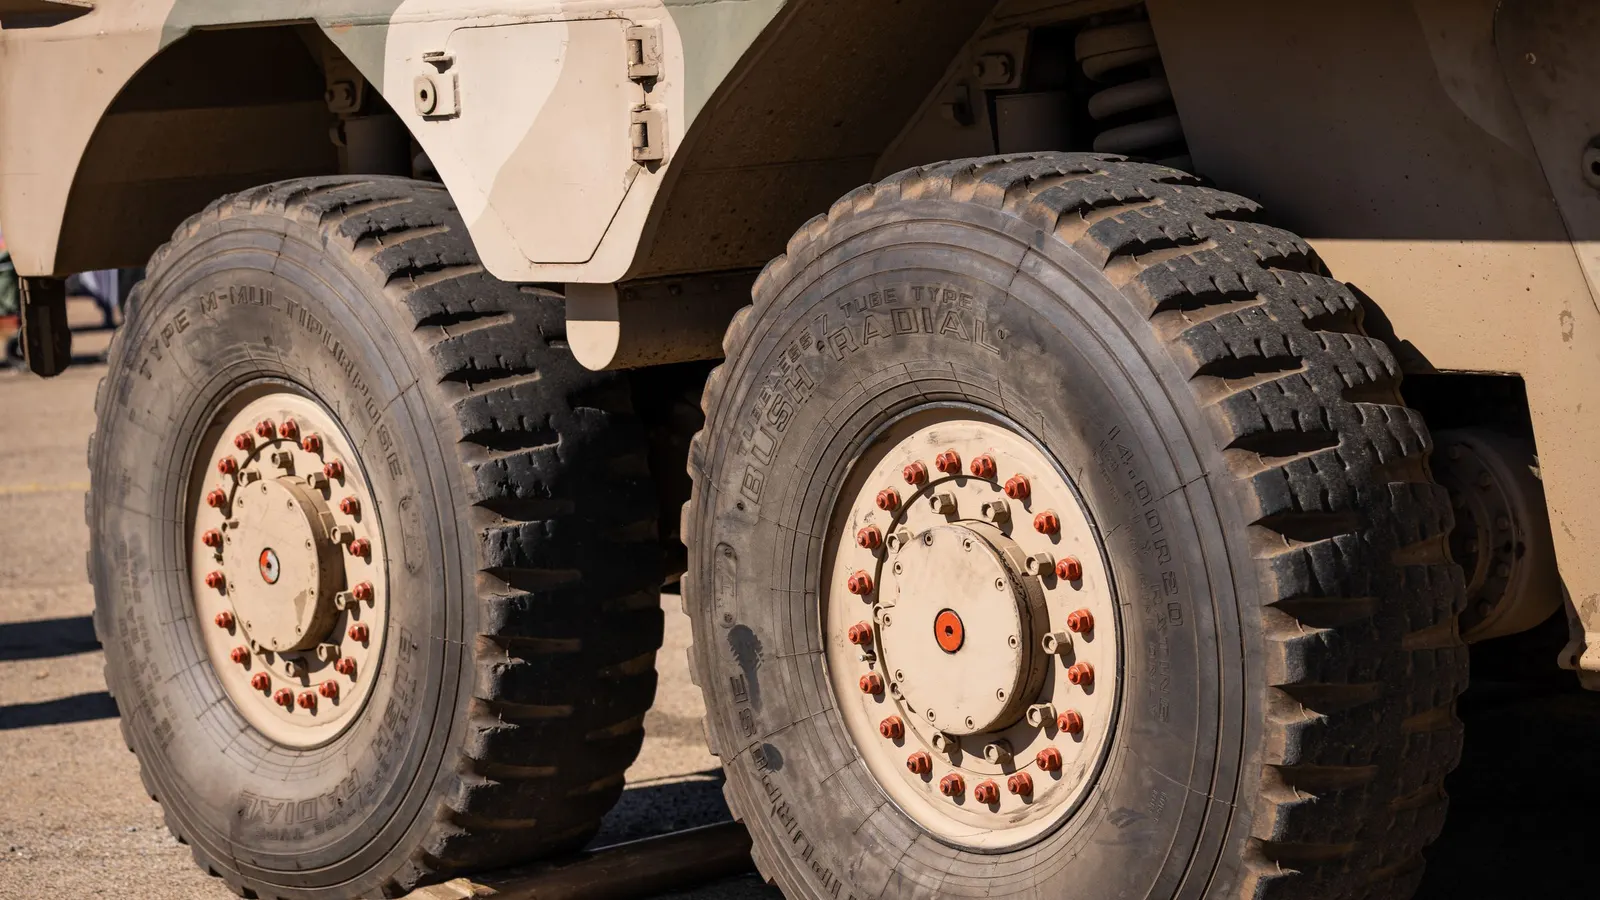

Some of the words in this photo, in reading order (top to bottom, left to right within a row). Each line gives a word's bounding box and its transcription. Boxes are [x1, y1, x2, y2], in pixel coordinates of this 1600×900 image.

[840, 286, 898, 318] TUBE
[911, 285, 974, 311] TYPE
[138, 308, 190, 381] TYPE
[741, 364, 816, 505] BUSH
[827, 306, 1001, 362] RADIAL
